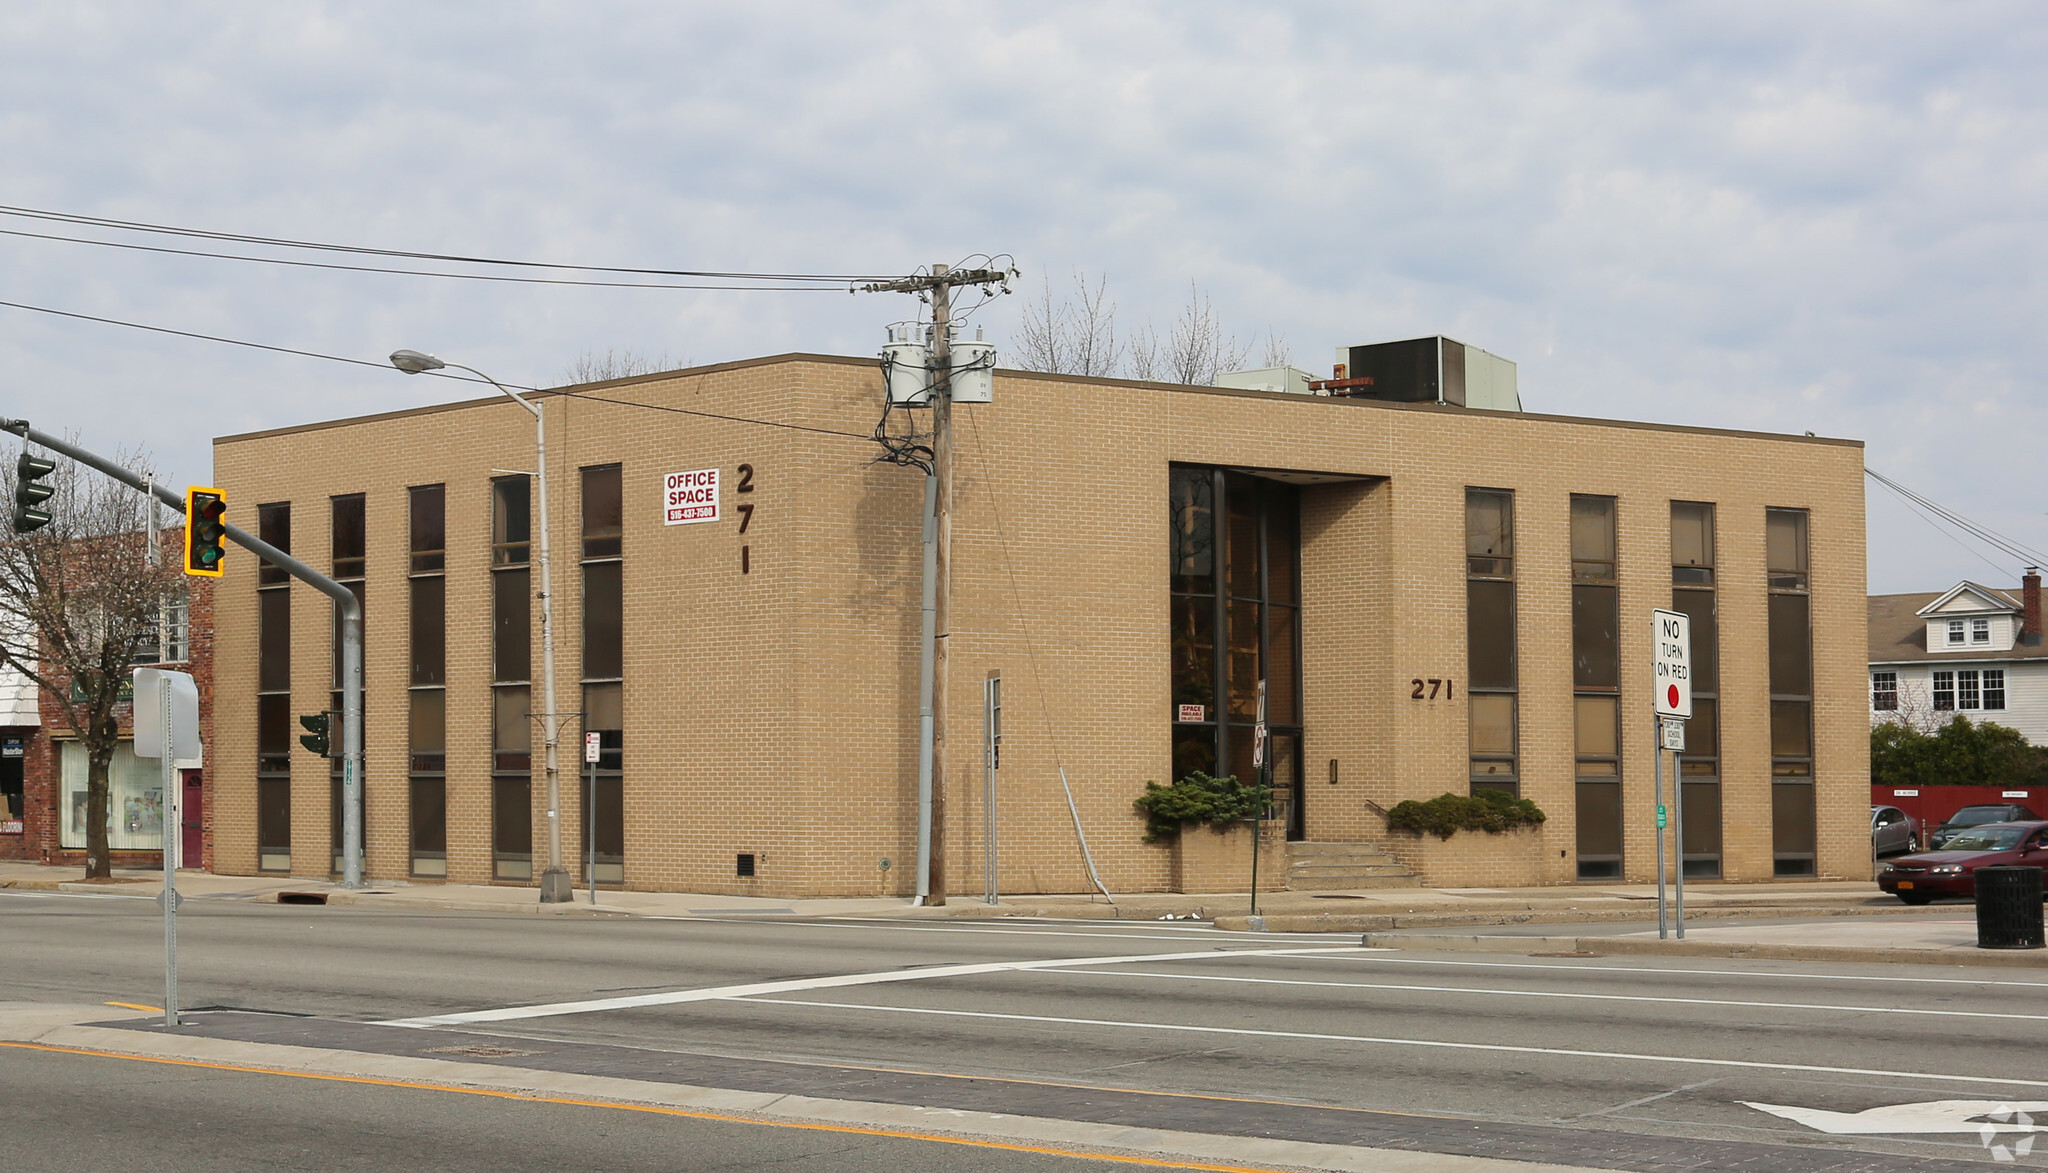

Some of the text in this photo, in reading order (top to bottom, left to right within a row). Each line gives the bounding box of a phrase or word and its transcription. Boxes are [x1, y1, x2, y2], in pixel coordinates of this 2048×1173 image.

[668, 471, 716, 489] OFFICE
[669, 488, 714, 505] SPACE
[670, 507, 713, 520] 516-437-7500
[1663, 619, 1680, 639] NO
[1662, 643, 1683, 659] TURN
[1658, 662, 1688, 680] ON RED
[1411, 678, 1452, 700] 271
